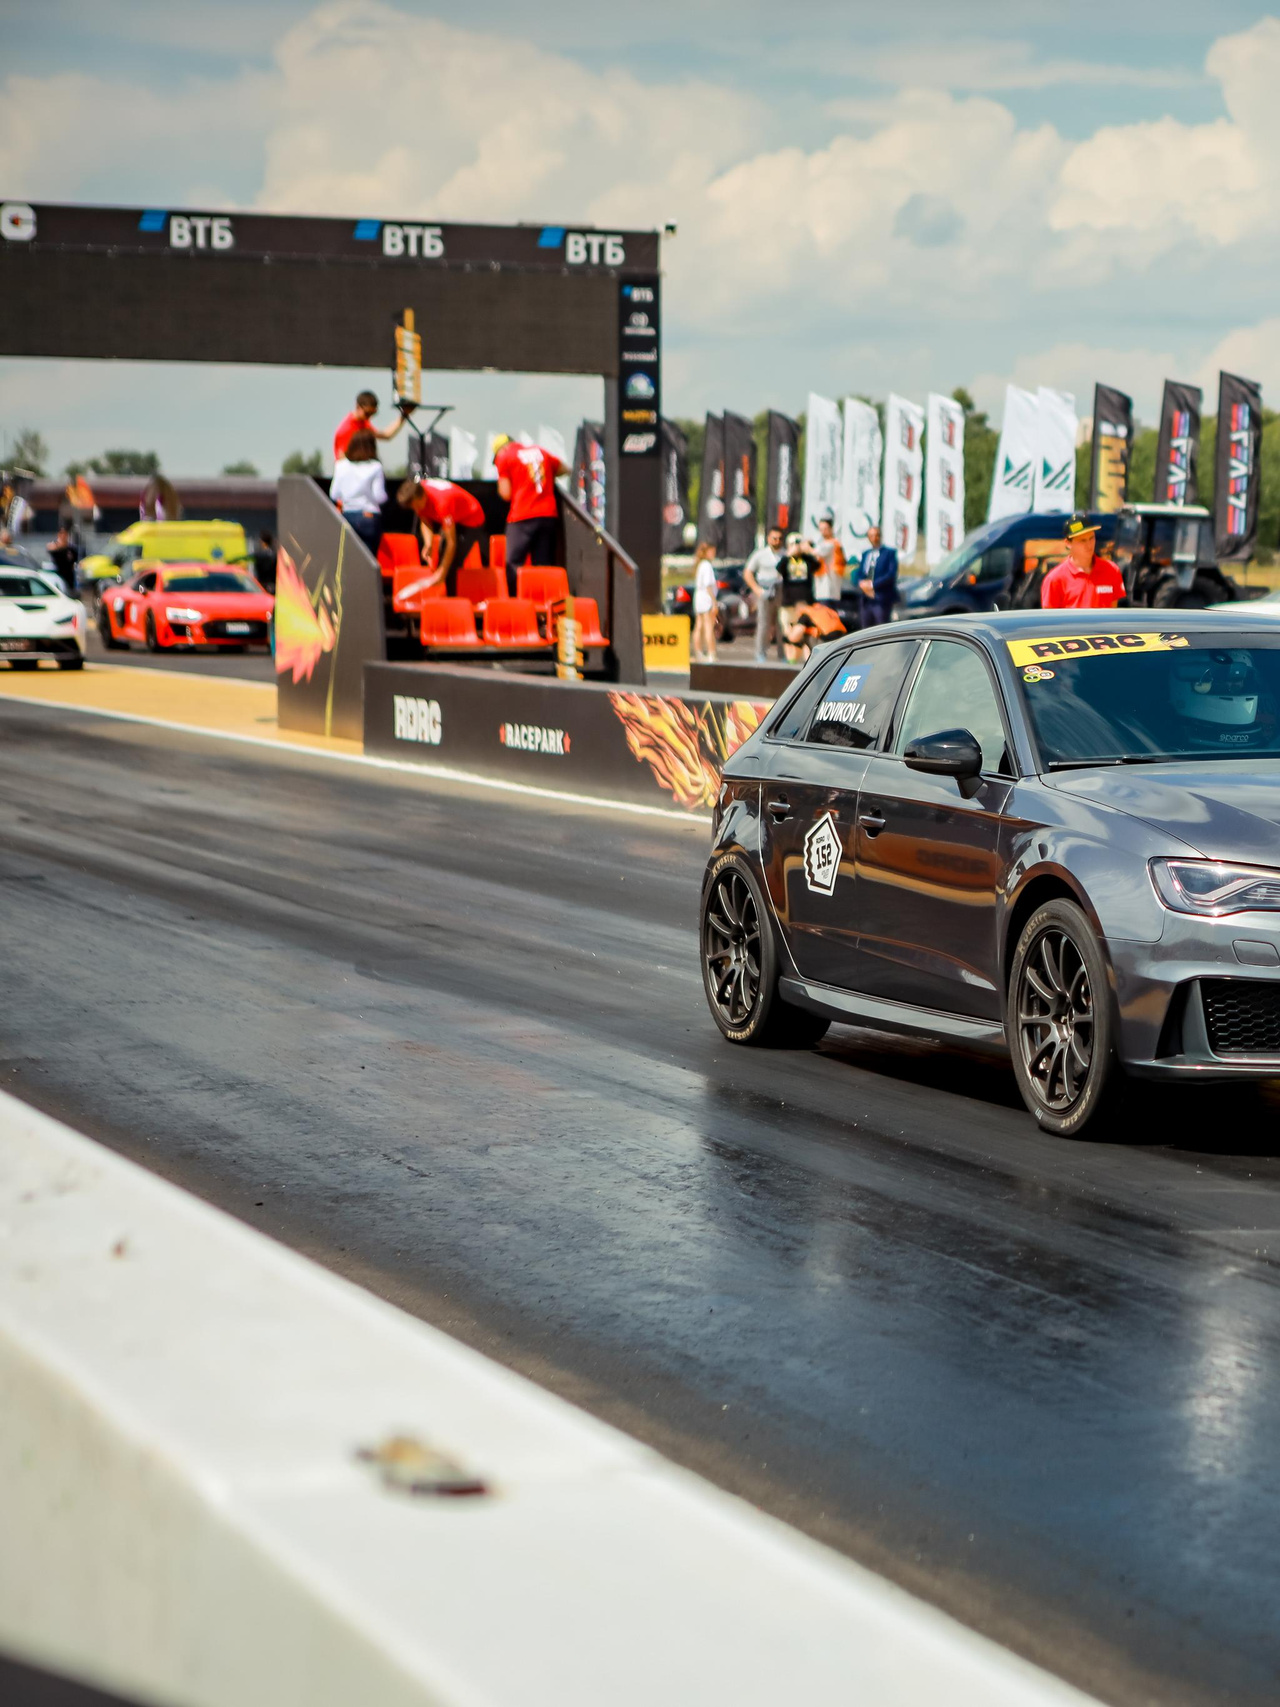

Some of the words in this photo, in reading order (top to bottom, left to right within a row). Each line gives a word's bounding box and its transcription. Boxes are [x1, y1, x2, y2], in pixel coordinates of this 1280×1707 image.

[169, 215, 234, 250] ВТБ
[383, 224, 444, 258] ВТБ
[565, 232, 626, 266] ВТБ
[1029, 634, 1147, 658] RDRC
[841, 674, 862, 693] ВТБ
[393, 694, 442, 746] RDRC
[816, 701, 861, 722] NOVIKOV
[854, 702, 867, 724] A.
[504, 722, 565, 755] RACEPARK
[815, 842, 833, 869] 152
